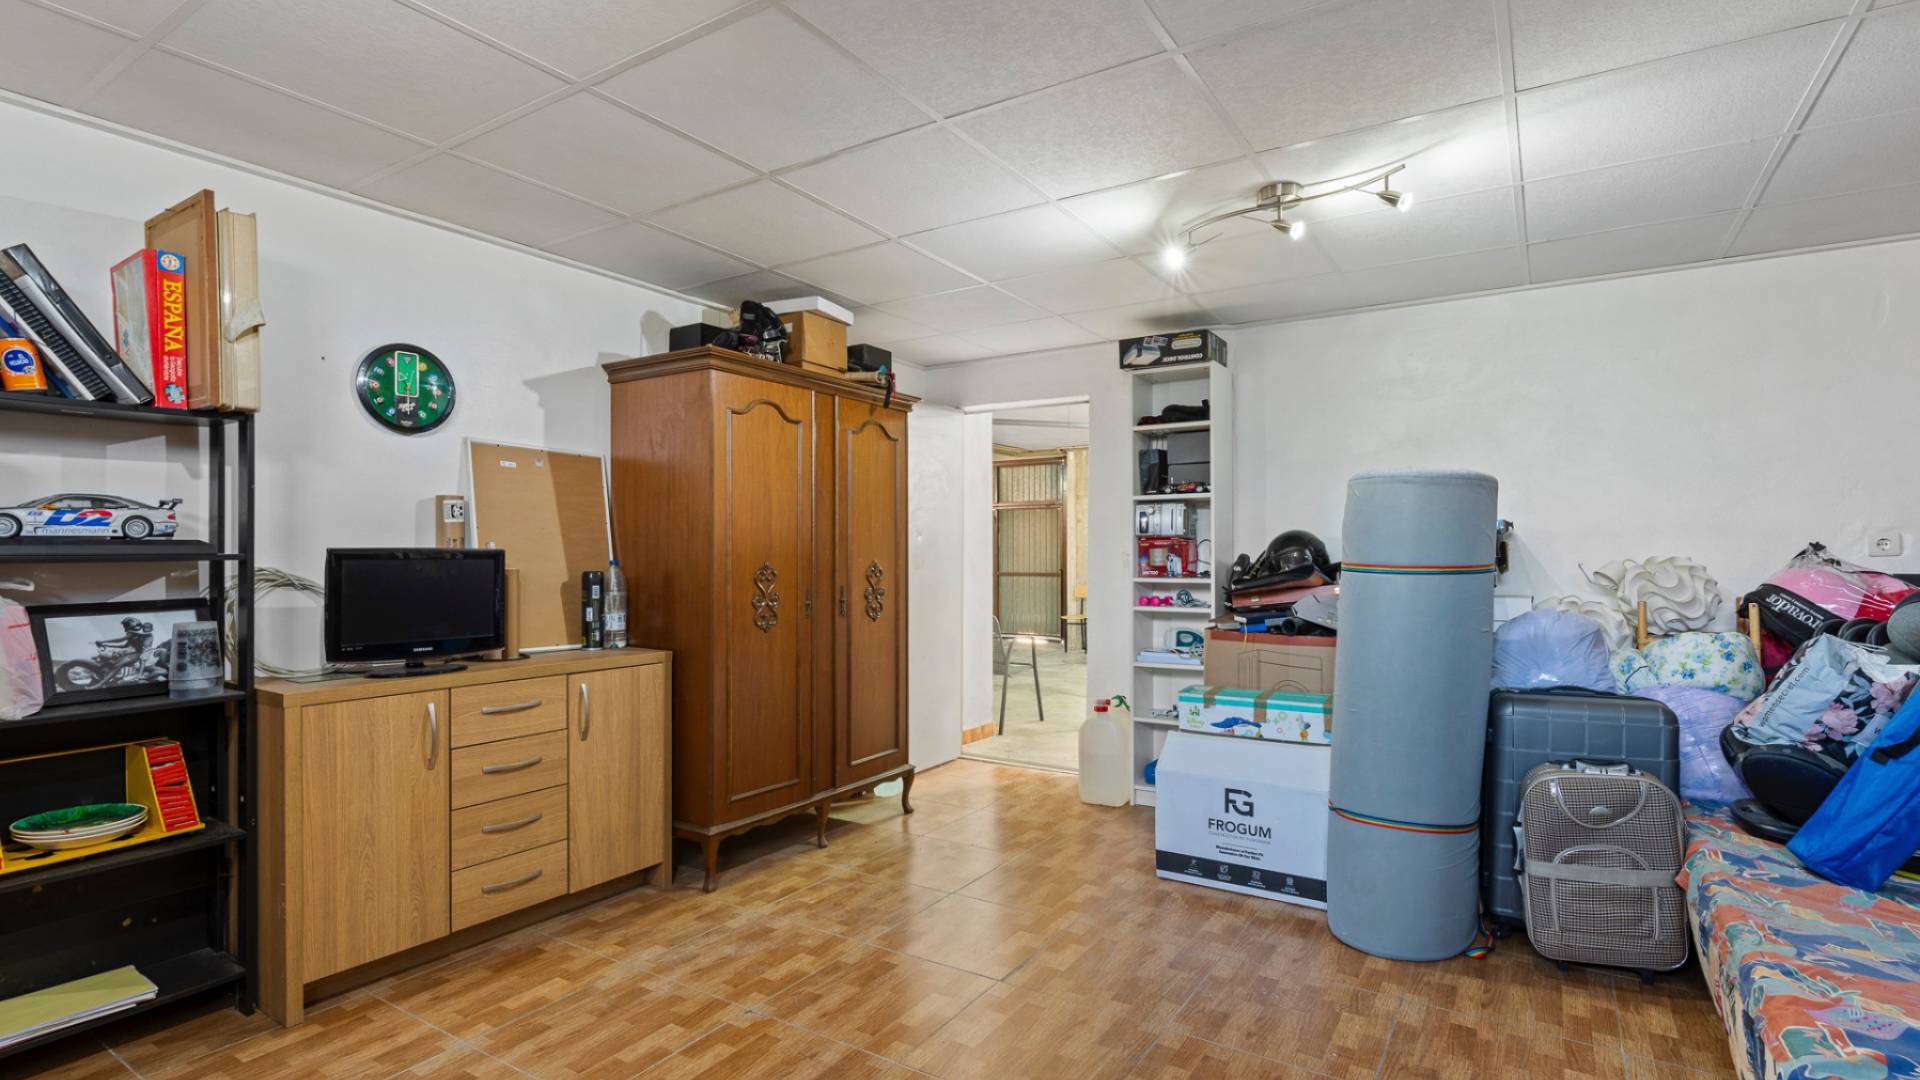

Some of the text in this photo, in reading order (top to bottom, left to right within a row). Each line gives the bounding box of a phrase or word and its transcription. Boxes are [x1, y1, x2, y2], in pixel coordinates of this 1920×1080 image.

[162, 279, 184, 352] ESPAÑA
[44, 508, 113, 526] D2
[1208, 818, 1272, 839] FROGUM
